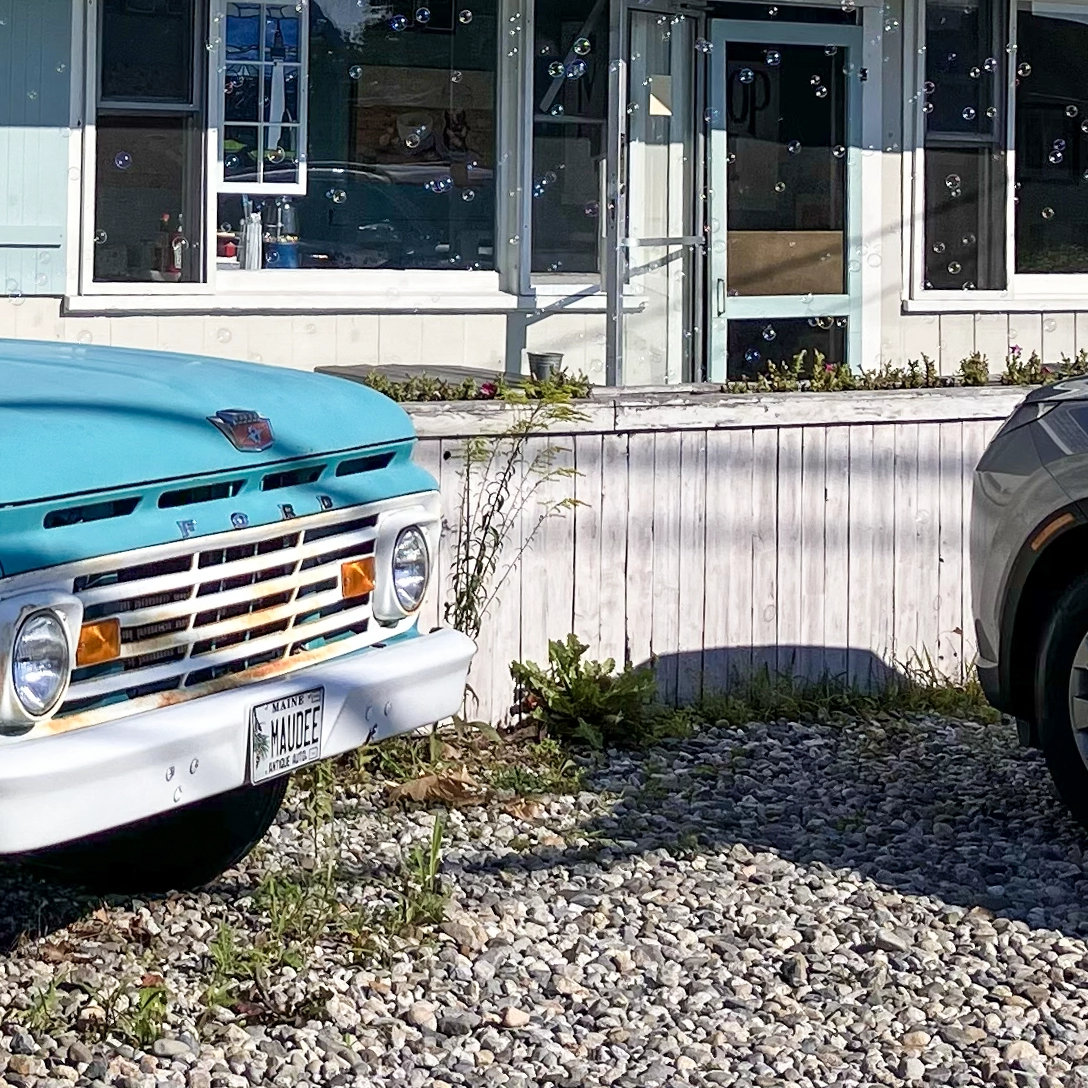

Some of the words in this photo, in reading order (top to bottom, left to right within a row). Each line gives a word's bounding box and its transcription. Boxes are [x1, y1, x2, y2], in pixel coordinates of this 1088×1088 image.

[176, 495, 333, 539] FORD
[273, 695, 304, 713] MAINE
[271, 705, 320, 758] MAUDEE
